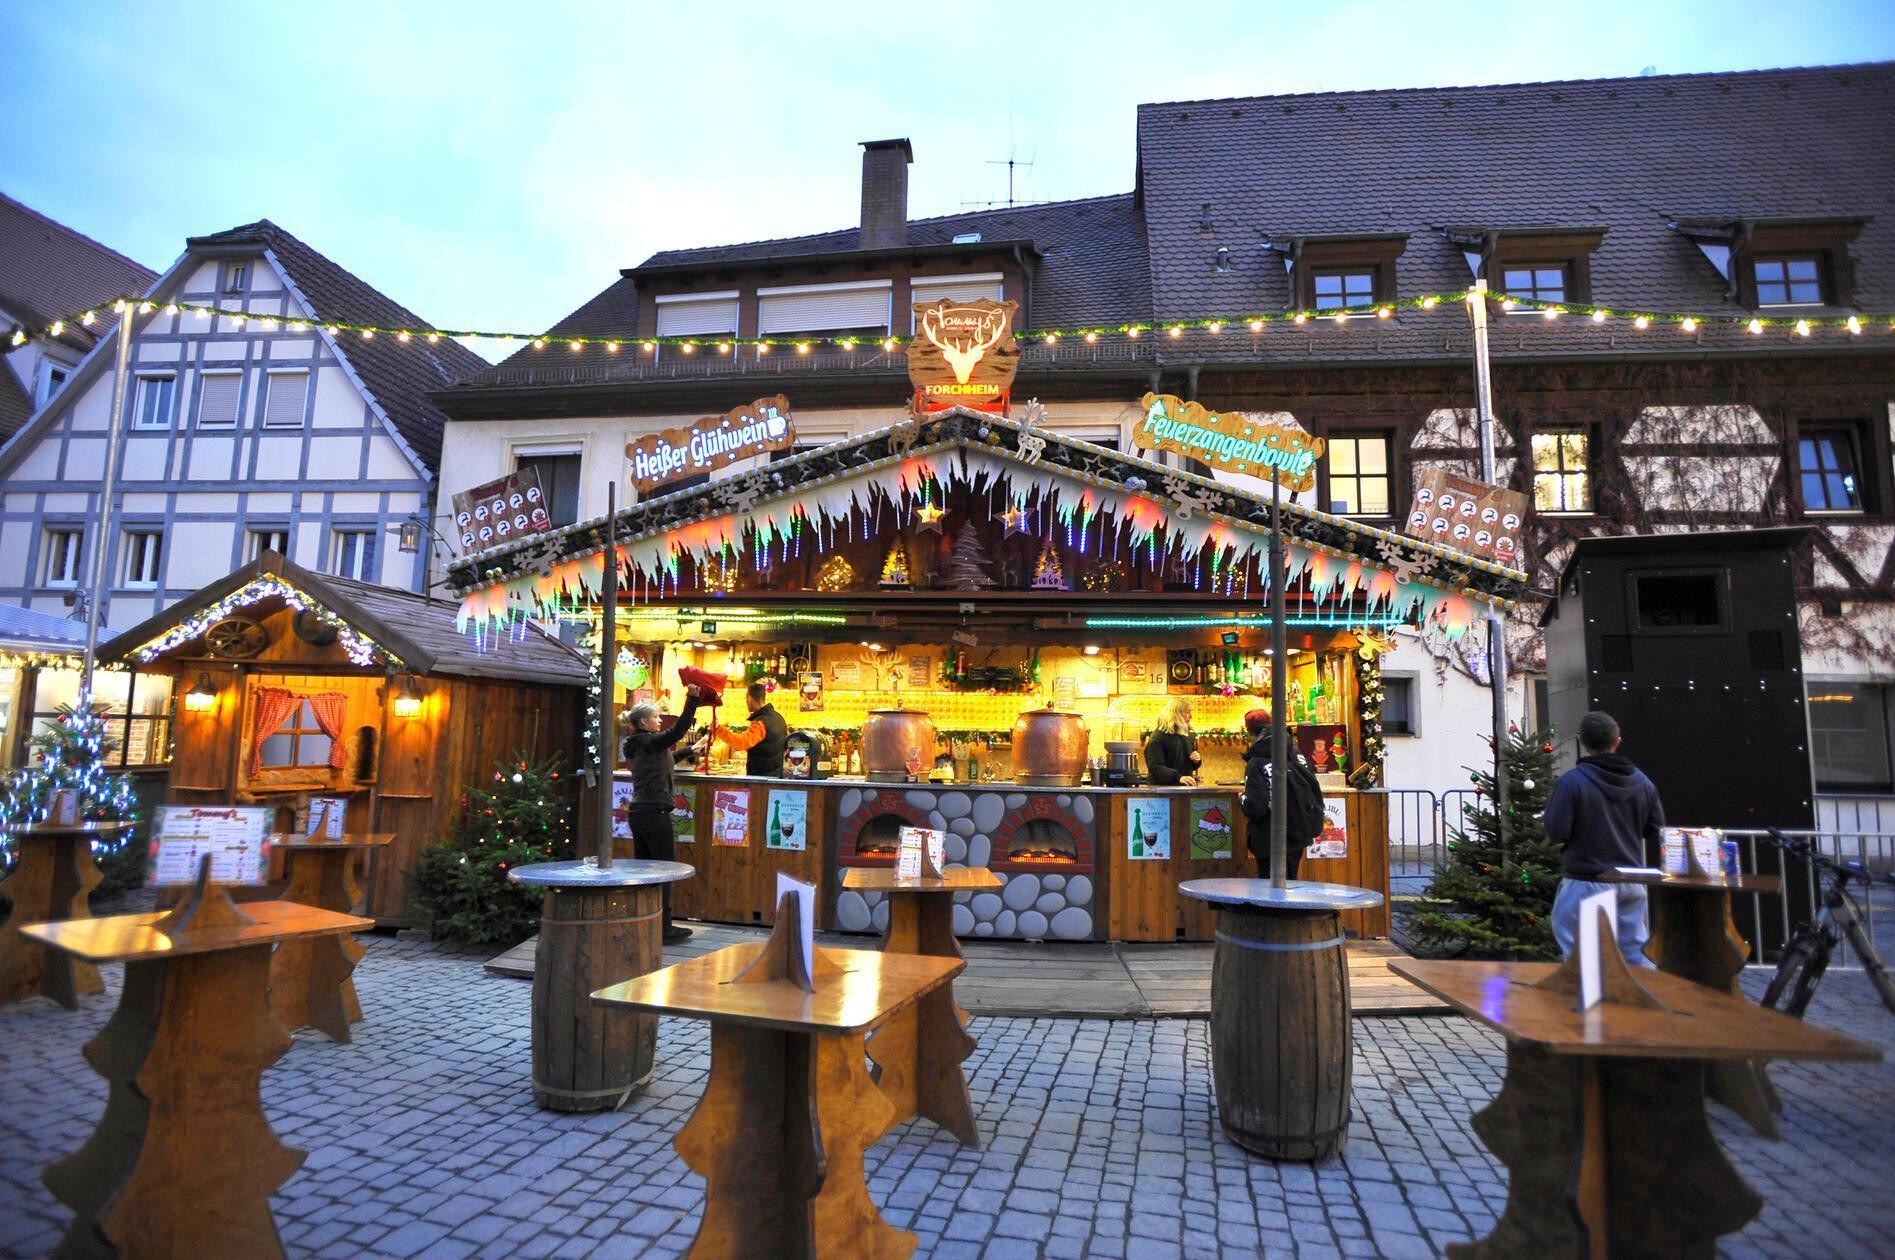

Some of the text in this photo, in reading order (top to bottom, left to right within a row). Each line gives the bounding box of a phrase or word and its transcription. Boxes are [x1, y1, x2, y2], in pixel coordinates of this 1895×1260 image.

[925, 384, 999, 395] FORCHHEIM
[635, 417, 768, 480] Heißer Glühwein
[1143, 406, 1312, 476] Feuerzangenbowle
[1150, 673, 1163, 684] 16
